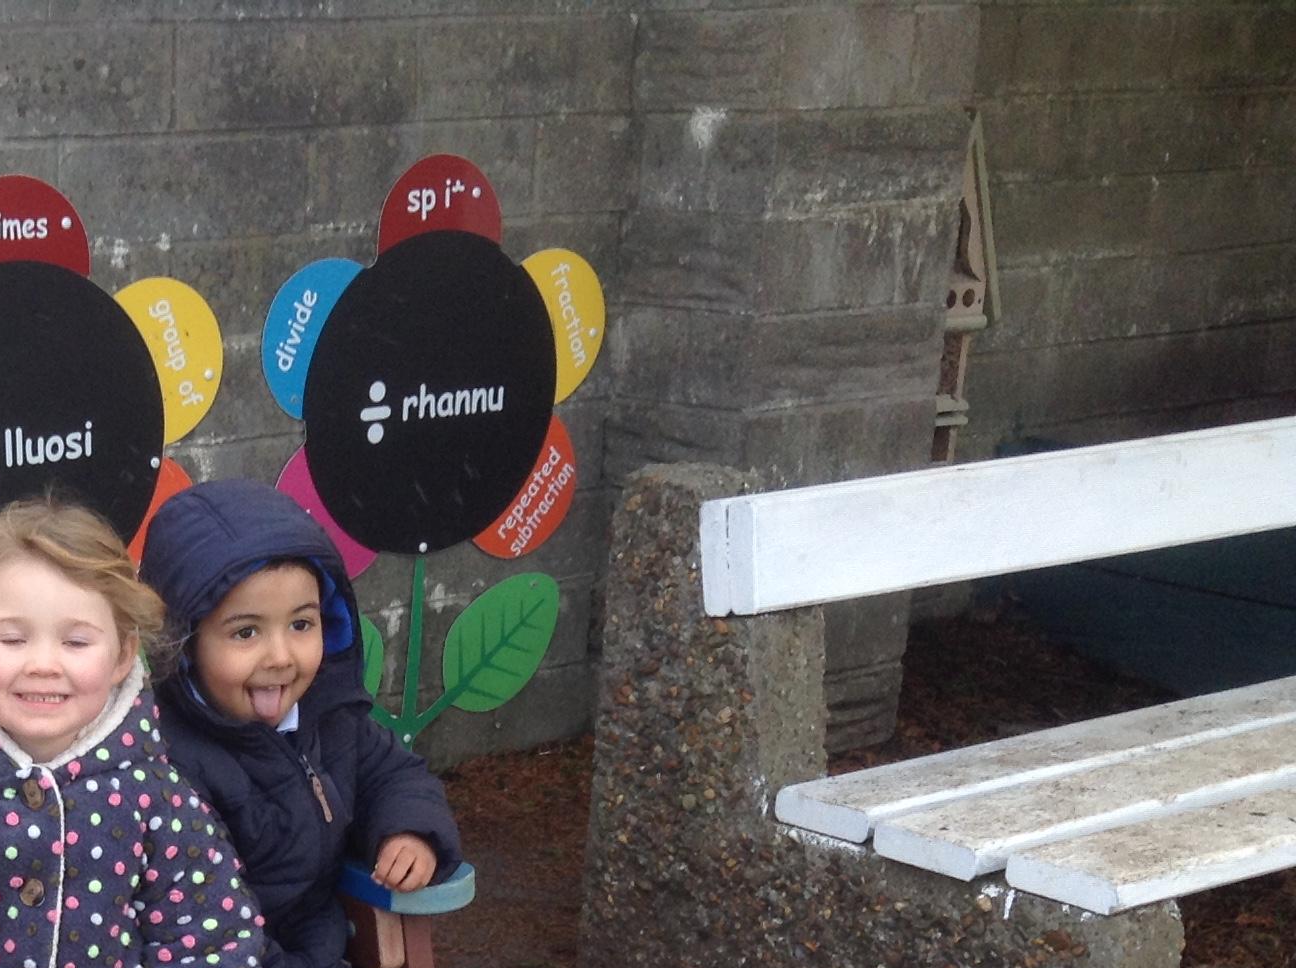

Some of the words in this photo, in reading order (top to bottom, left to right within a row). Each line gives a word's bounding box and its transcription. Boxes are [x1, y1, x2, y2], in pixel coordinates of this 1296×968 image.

[148, 299, 186, 371] group
[178, 380, 204, 406] of
[275, 289, 318, 372] divide
[550, 262, 587, 369] fraction
[4, 420, 92, 468] lluosi
[402, 383, 505, 422] rhannu
[497, 445, 561, 539] repeated
[510, 463, 575, 557] subtraction
